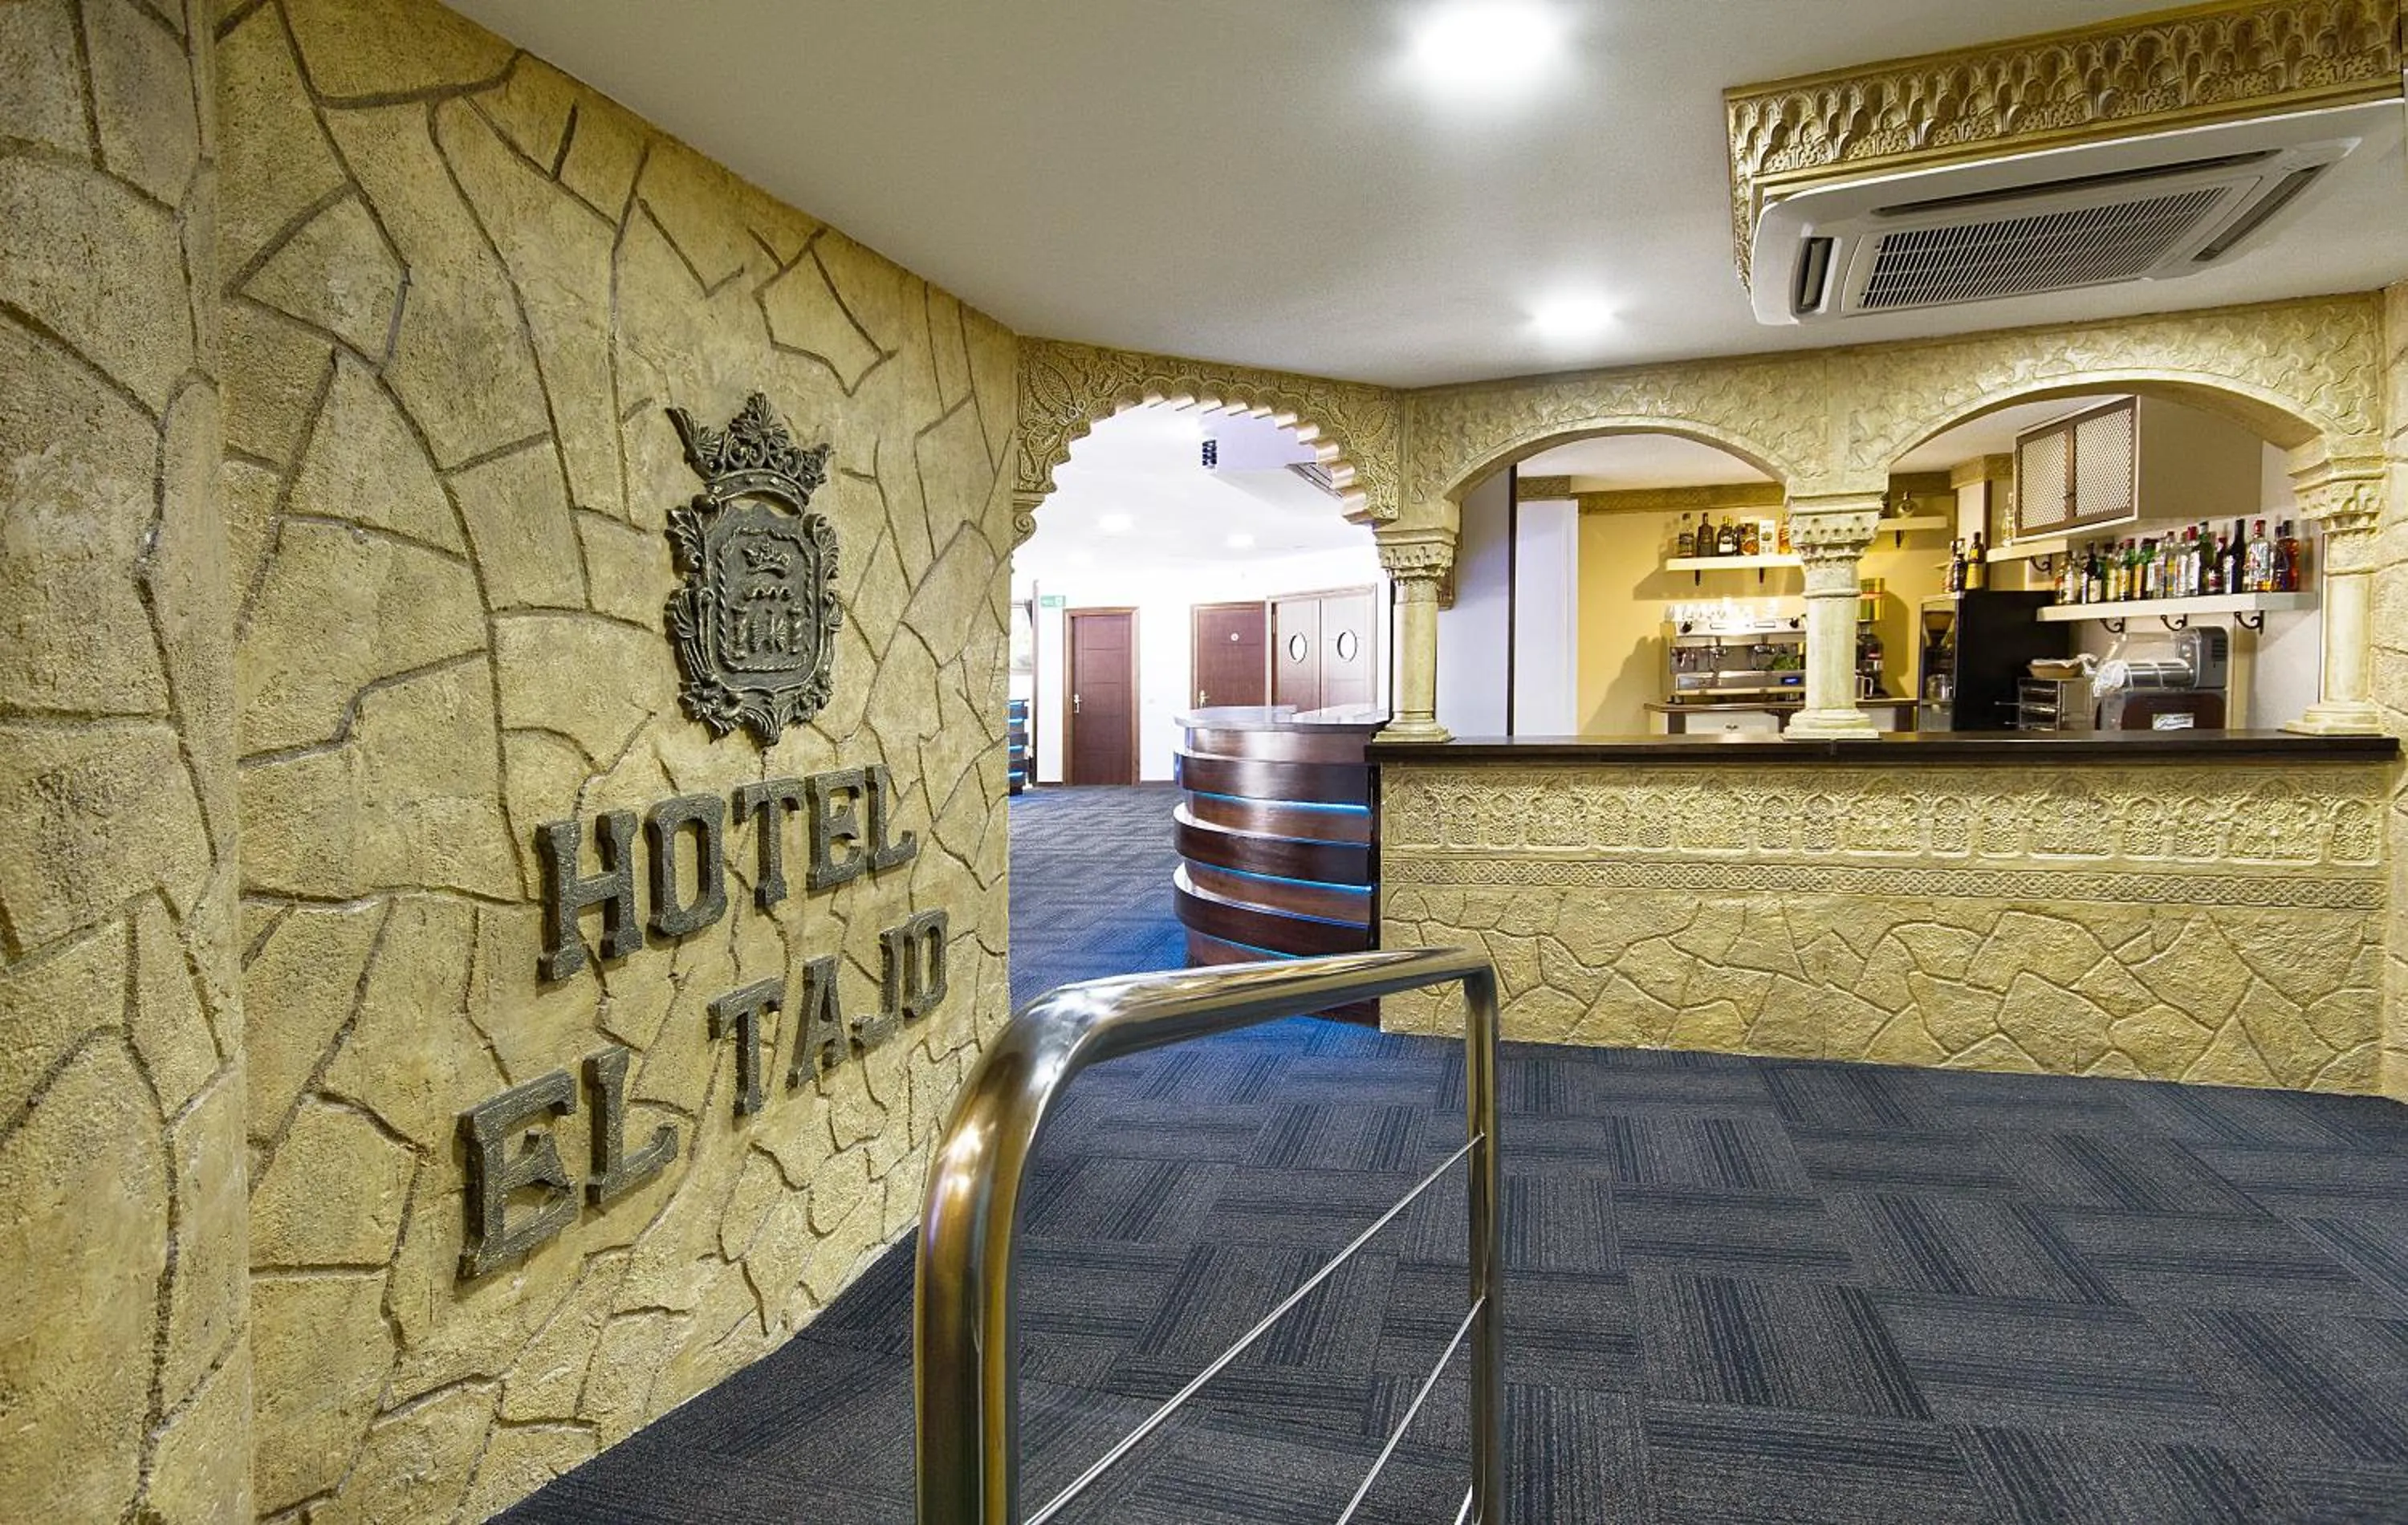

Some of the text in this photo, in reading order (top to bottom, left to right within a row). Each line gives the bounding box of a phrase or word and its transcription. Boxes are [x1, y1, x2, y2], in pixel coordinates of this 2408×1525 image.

[535, 765, 917, 982] HOTEL
[456, 908, 950, 1283] EL TAJO
